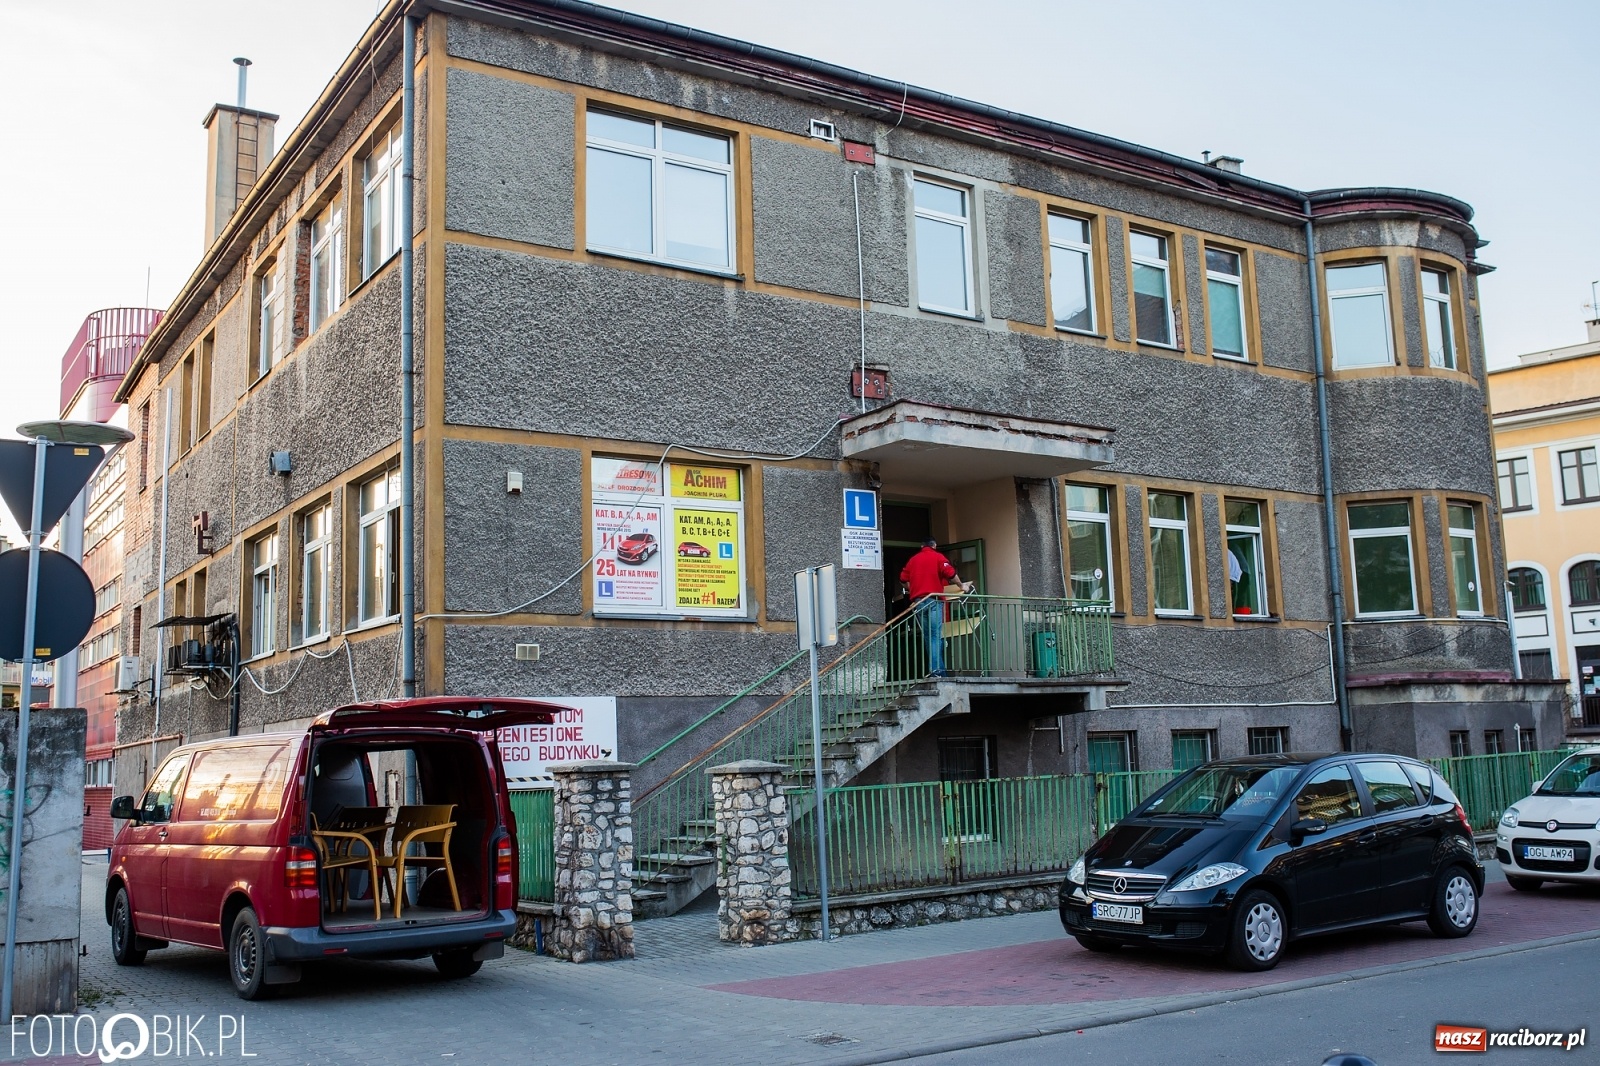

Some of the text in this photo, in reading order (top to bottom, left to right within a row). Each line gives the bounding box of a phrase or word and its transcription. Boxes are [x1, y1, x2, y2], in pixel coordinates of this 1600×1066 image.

[684, 469, 727, 489] ACHIM
[596, 509, 609, 518] KAT.
[854, 496, 870, 521] L
[680, 516, 692, 524] KAT.
[718, 529, 730, 537] C+E
[722, 545, 730, 556] L
[596, 558, 616, 576] 25
[637, 570, 659, 578] RYNKU!
[602, 582, 610, 596] L
[702, 591, 716, 605] #1
[539, 745, 599, 760] BUDYNKU
[1530, 848, 1573, 858] OGL AW94
[1098, 904, 1116, 917] SRC
